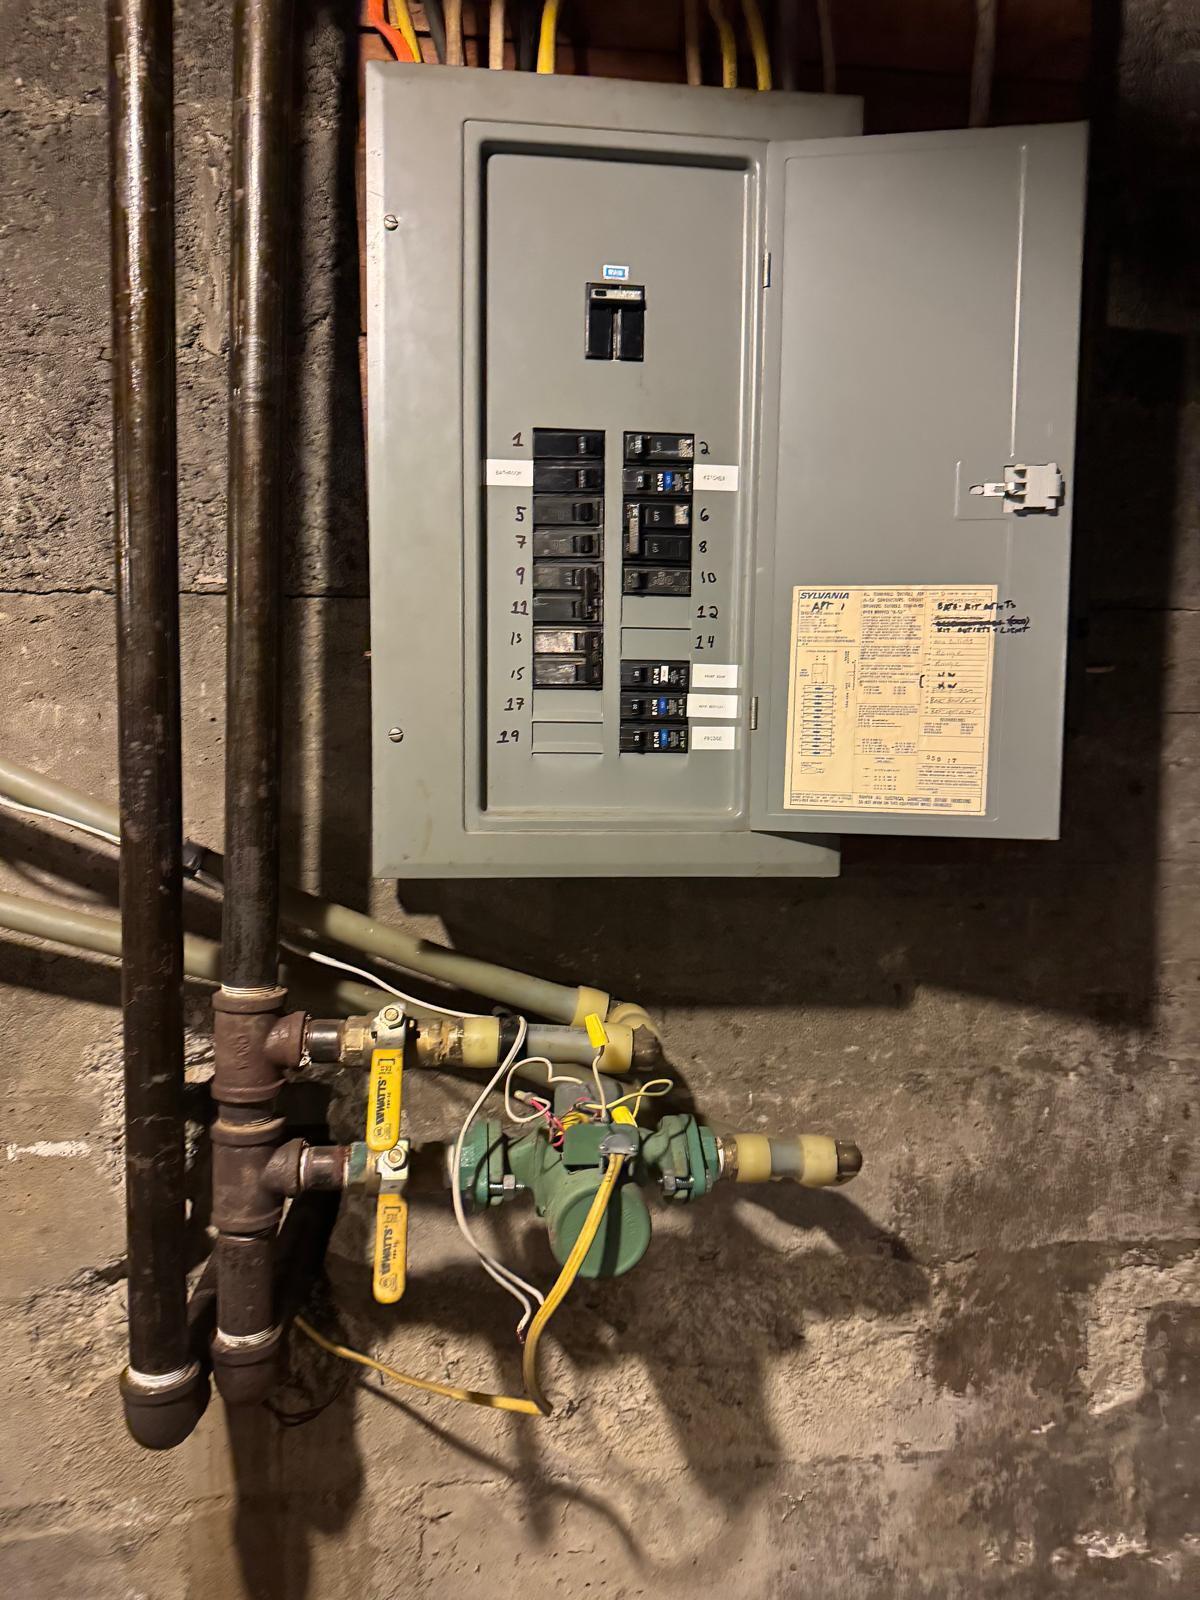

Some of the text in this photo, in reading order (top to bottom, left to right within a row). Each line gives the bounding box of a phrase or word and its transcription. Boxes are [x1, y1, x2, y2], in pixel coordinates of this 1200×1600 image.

[512, 432, 524, 447] 1
[700, 441, 710, 455] 2
[515, 506, 527, 522] 5
[700, 508, 710, 521] 6
[515, 535, 527, 549] 7
[699, 540, 708, 553] 8
[515, 566, 526, 585] 9
[701, 571, 717, 584] 10
[800, 592, 850, 600] SYLVANIA
[510, 600, 529, 616] 11
[697, 605, 719, 620] 12
[811, 601, 834, 613] APT
[694, 635, 715, 650] 14
[511, 666, 526, 681] 15
[504, 697, 525, 711] 17
[496, 730, 520, 744] 19
[375, 1079, 387, 1126] WATTS
[379, 1228, 393, 1275] WATTS
